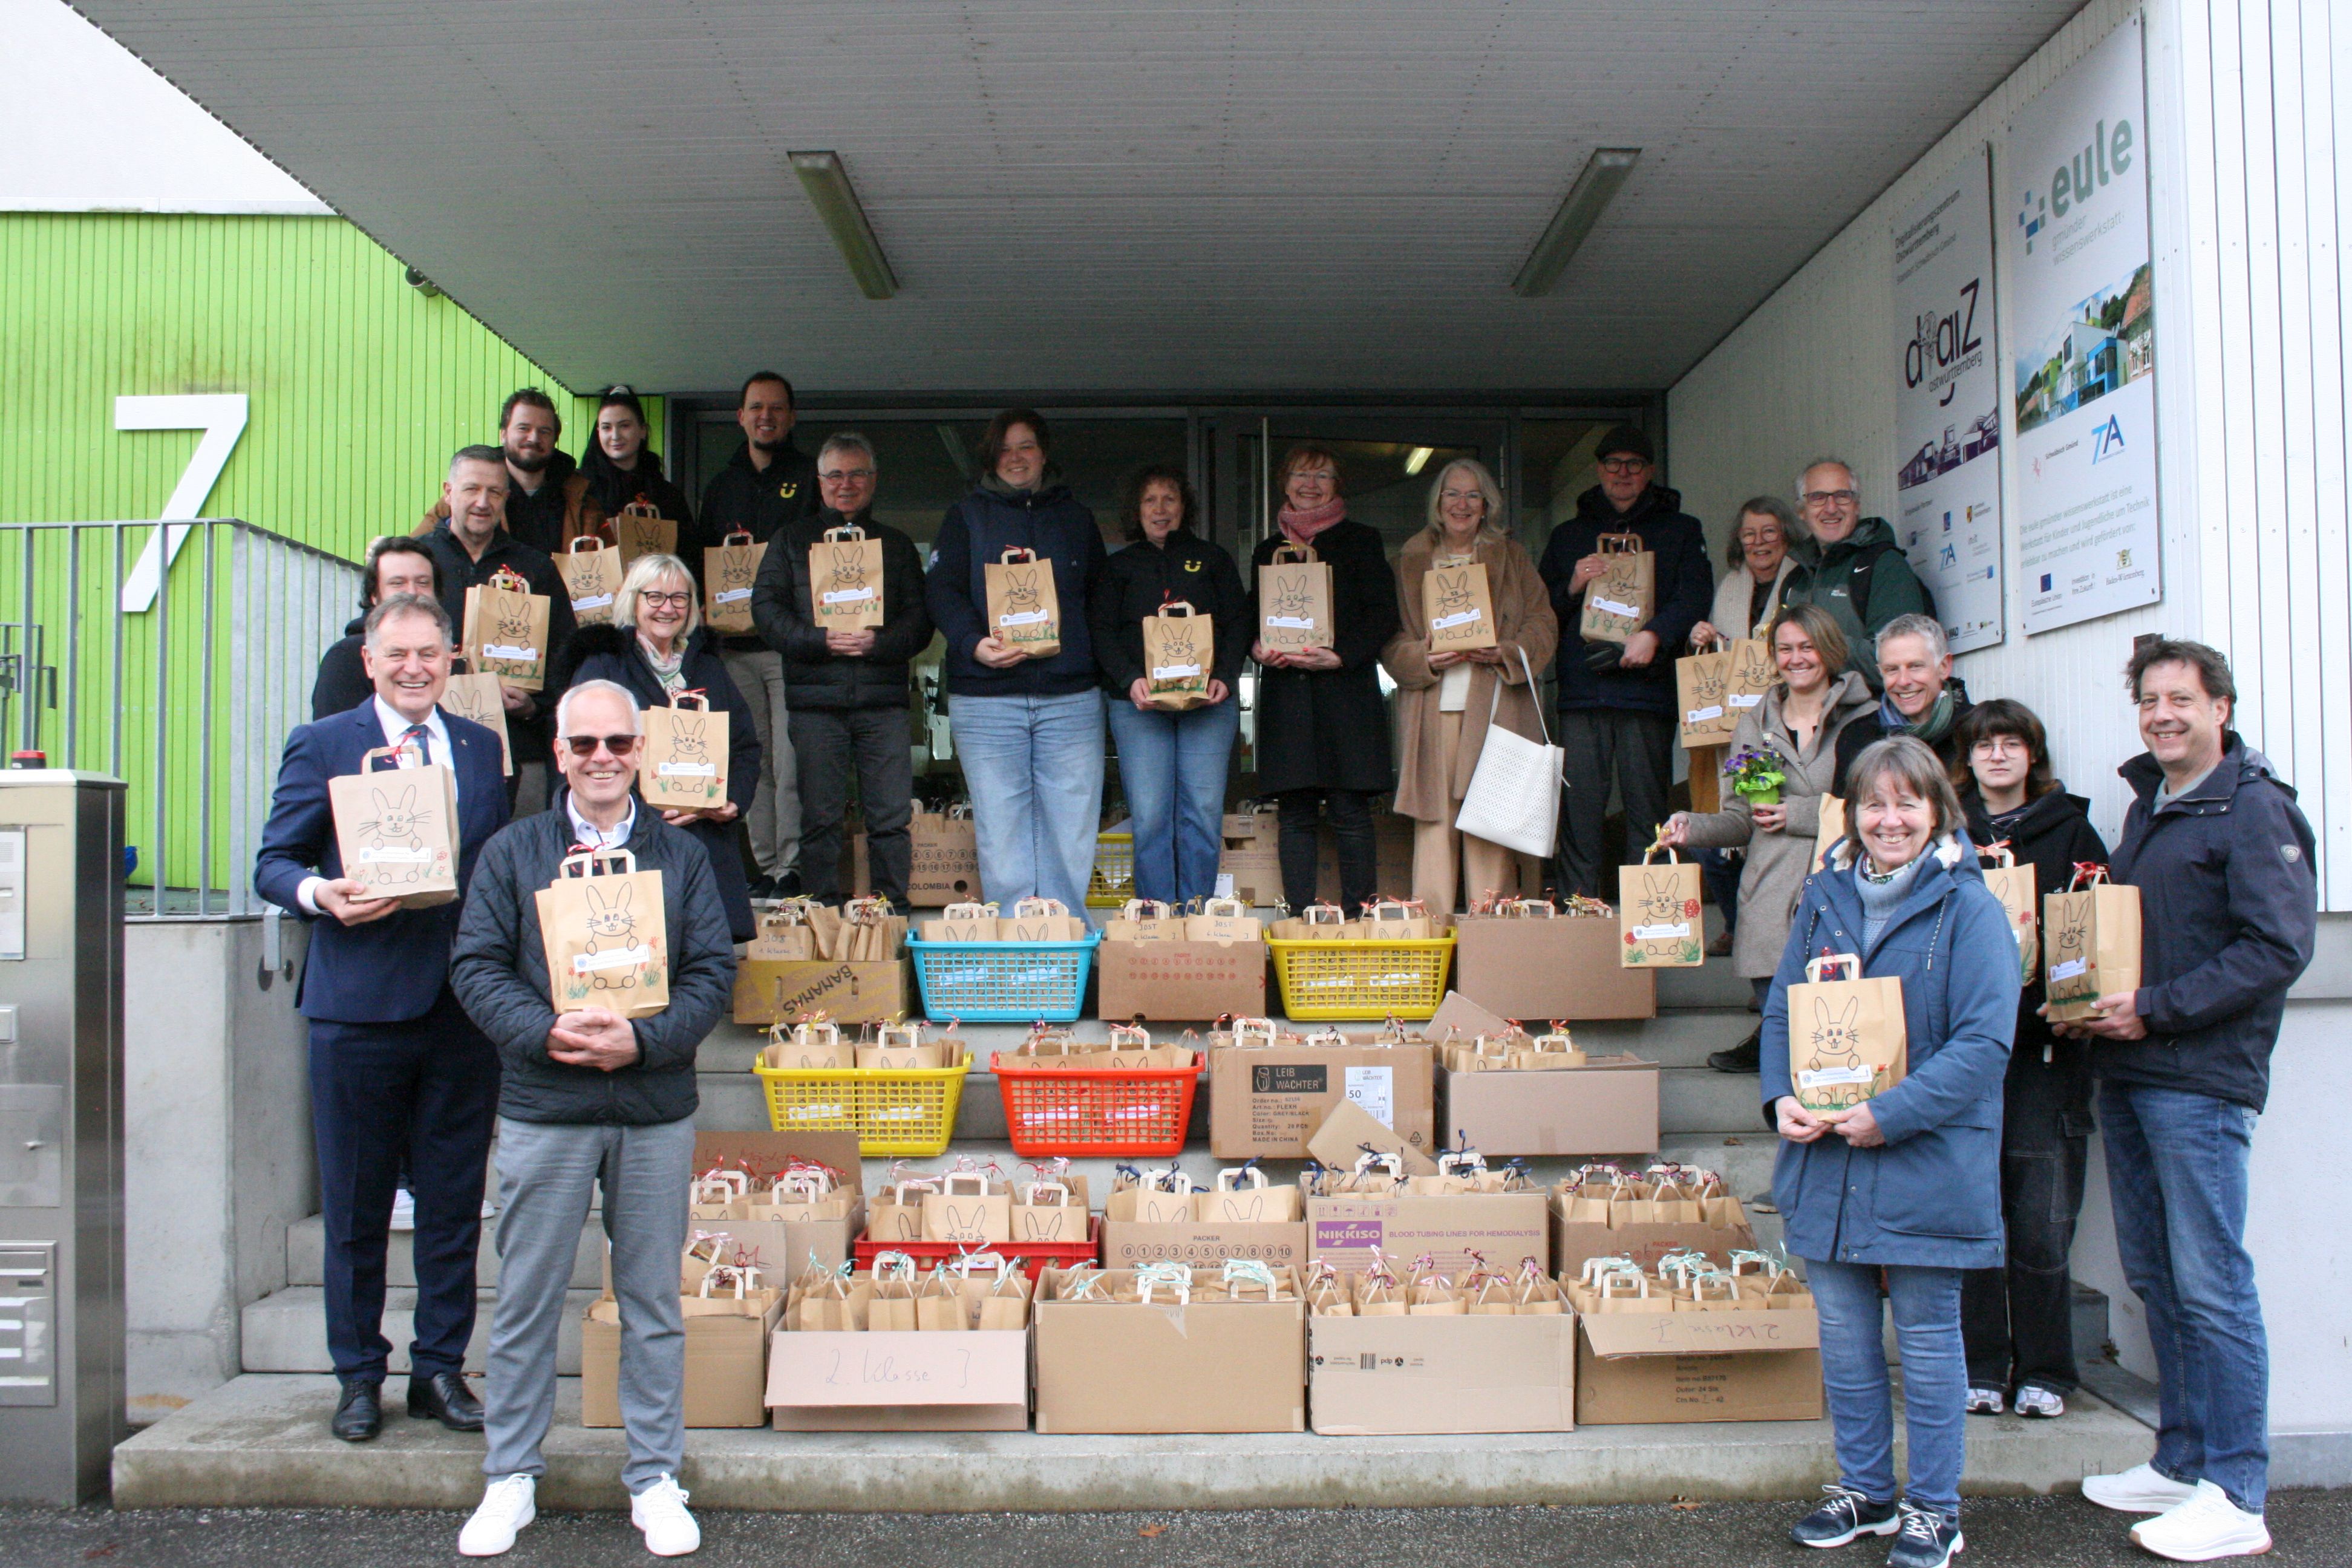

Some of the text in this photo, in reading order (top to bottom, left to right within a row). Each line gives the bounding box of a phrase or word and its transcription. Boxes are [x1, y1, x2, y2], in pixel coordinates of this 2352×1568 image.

[2051, 119, 2133, 219] eule
[2052, 214, 2088, 252] gmünder
[114, 394, 249, 612] 7
[2118, 485, 2132, 498] eine
[2082, 509, 2114, 531] Jugendliche
[2126, 495, 2150, 514] Technik
[783, 964, 853, 1016] BANANAS
[1276, 1068, 1295, 1077] LEIB
[1348, 1089, 1362, 1099] 50
[1318, 1229, 1381, 1240] NIKKISO
[863, 1348, 931, 1383] Klasse
